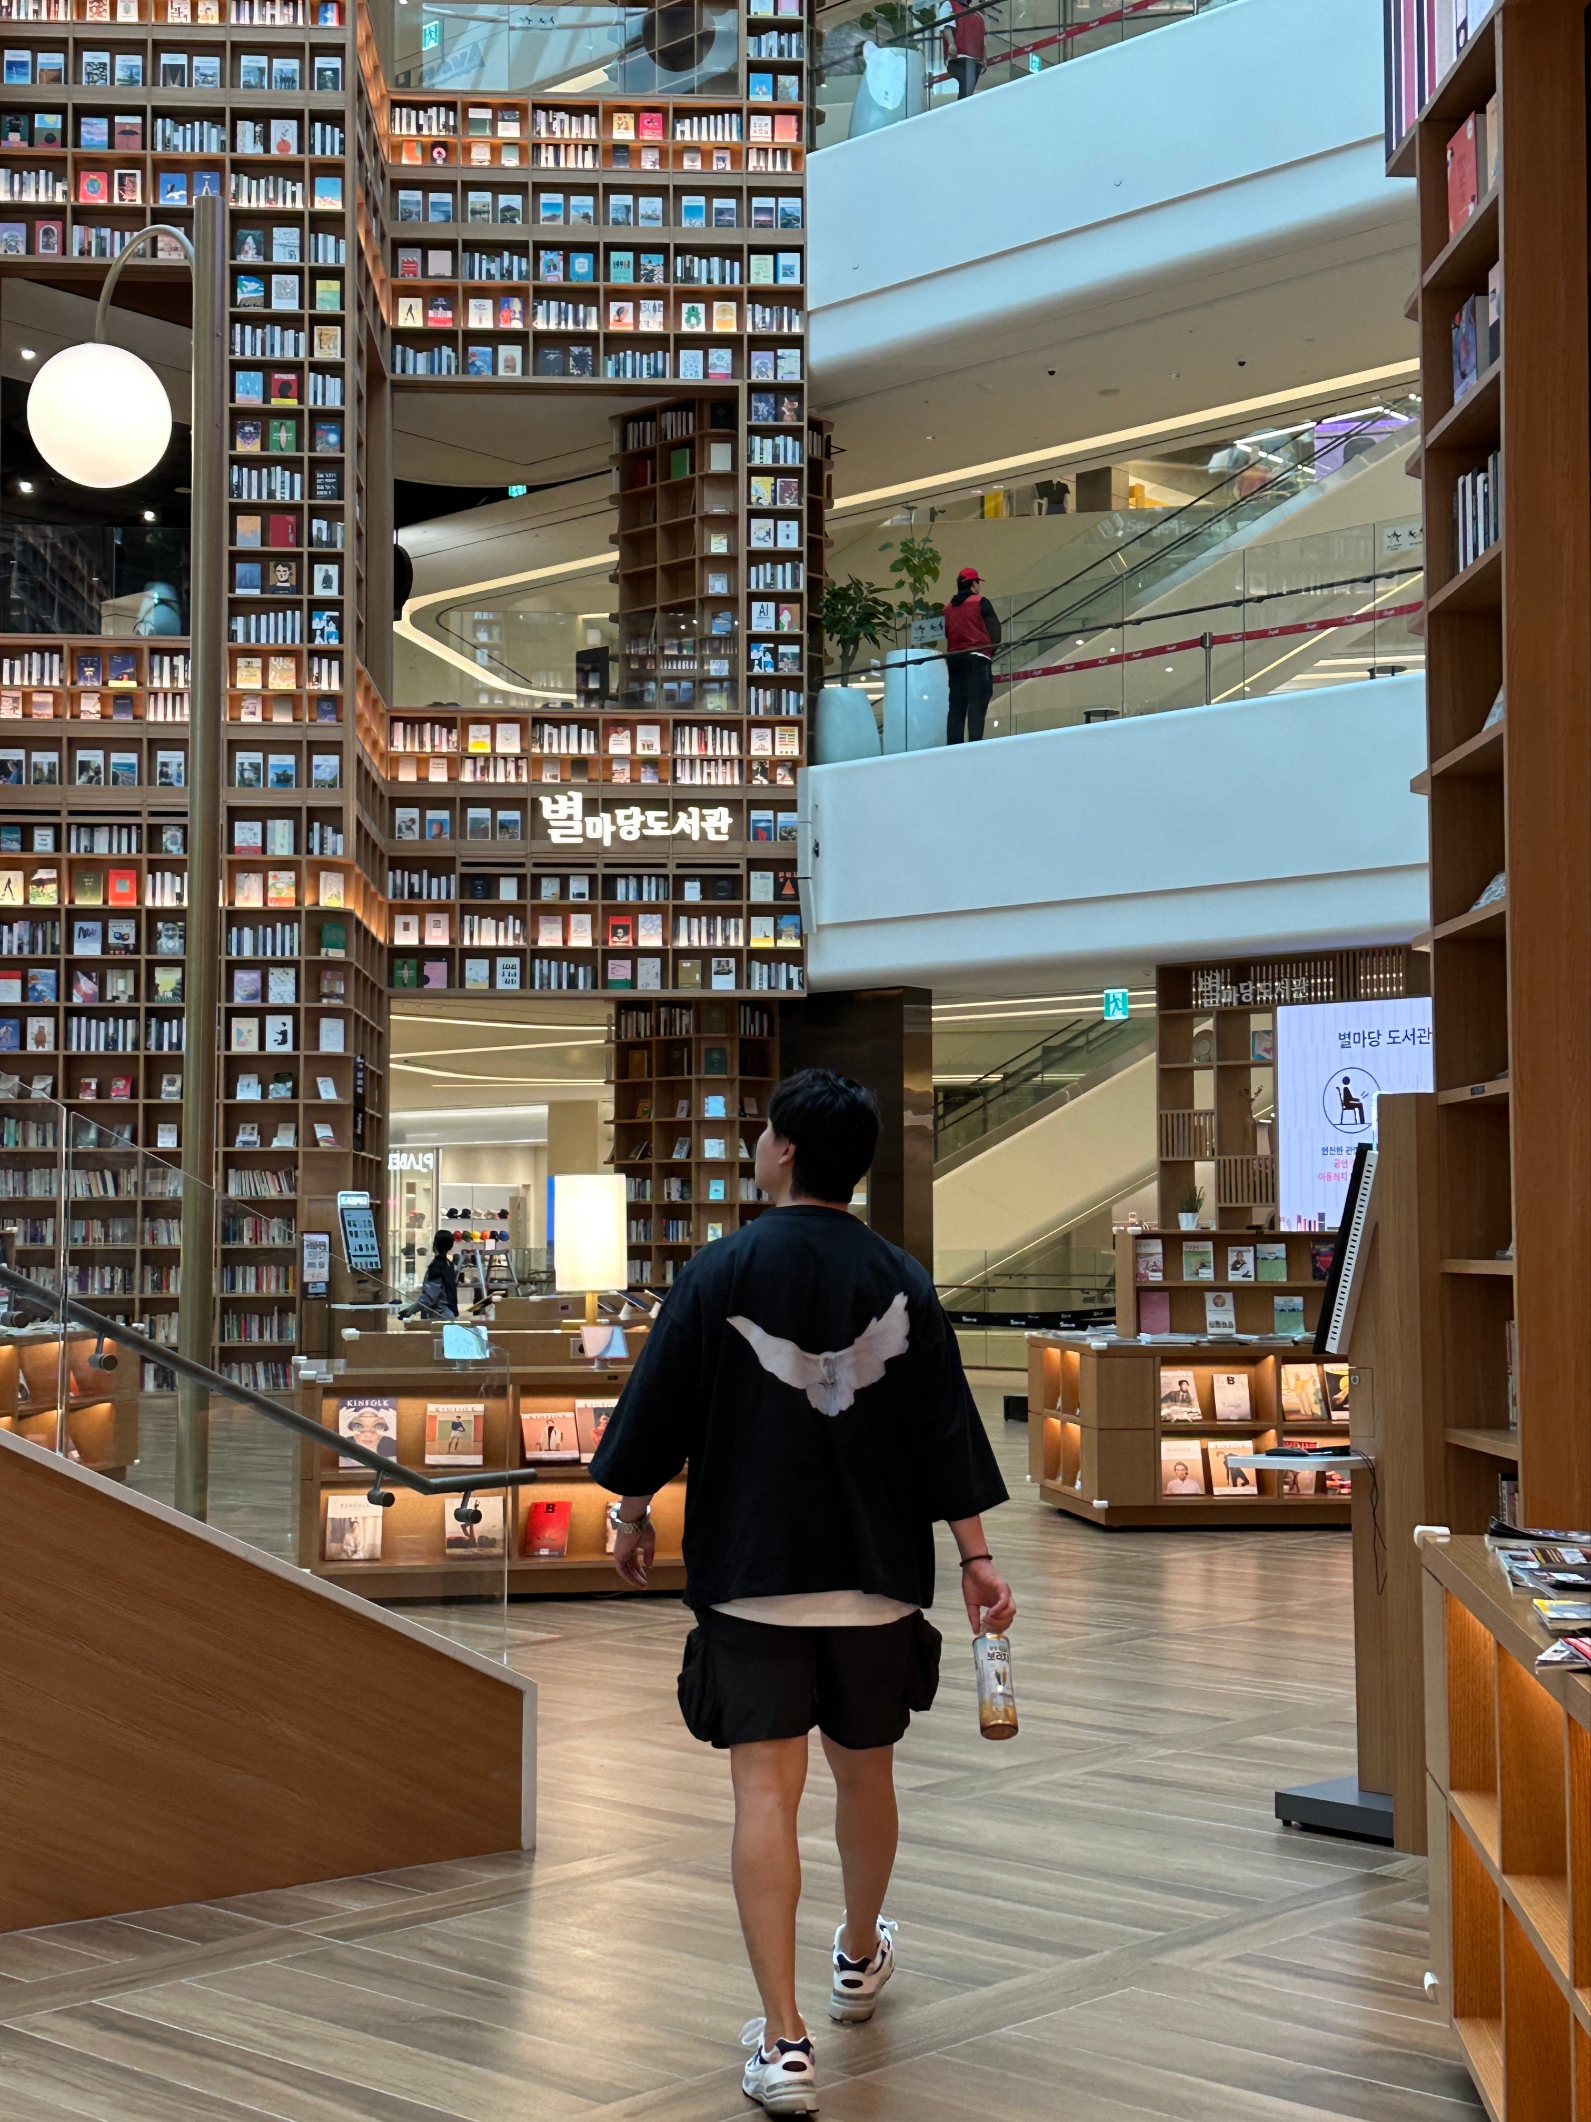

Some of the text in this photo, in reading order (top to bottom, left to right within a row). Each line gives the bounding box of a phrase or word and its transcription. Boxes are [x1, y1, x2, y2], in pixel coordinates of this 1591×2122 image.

[539, 791, 733, 846] 별마당도서관
[1338, 1026, 1432, 1049] 별마당 도서관
[1226, 1376, 1236, 1385] B
[346, 1399, 390, 1407] KINFOLK
[544, 1503, 557, 1514] B
